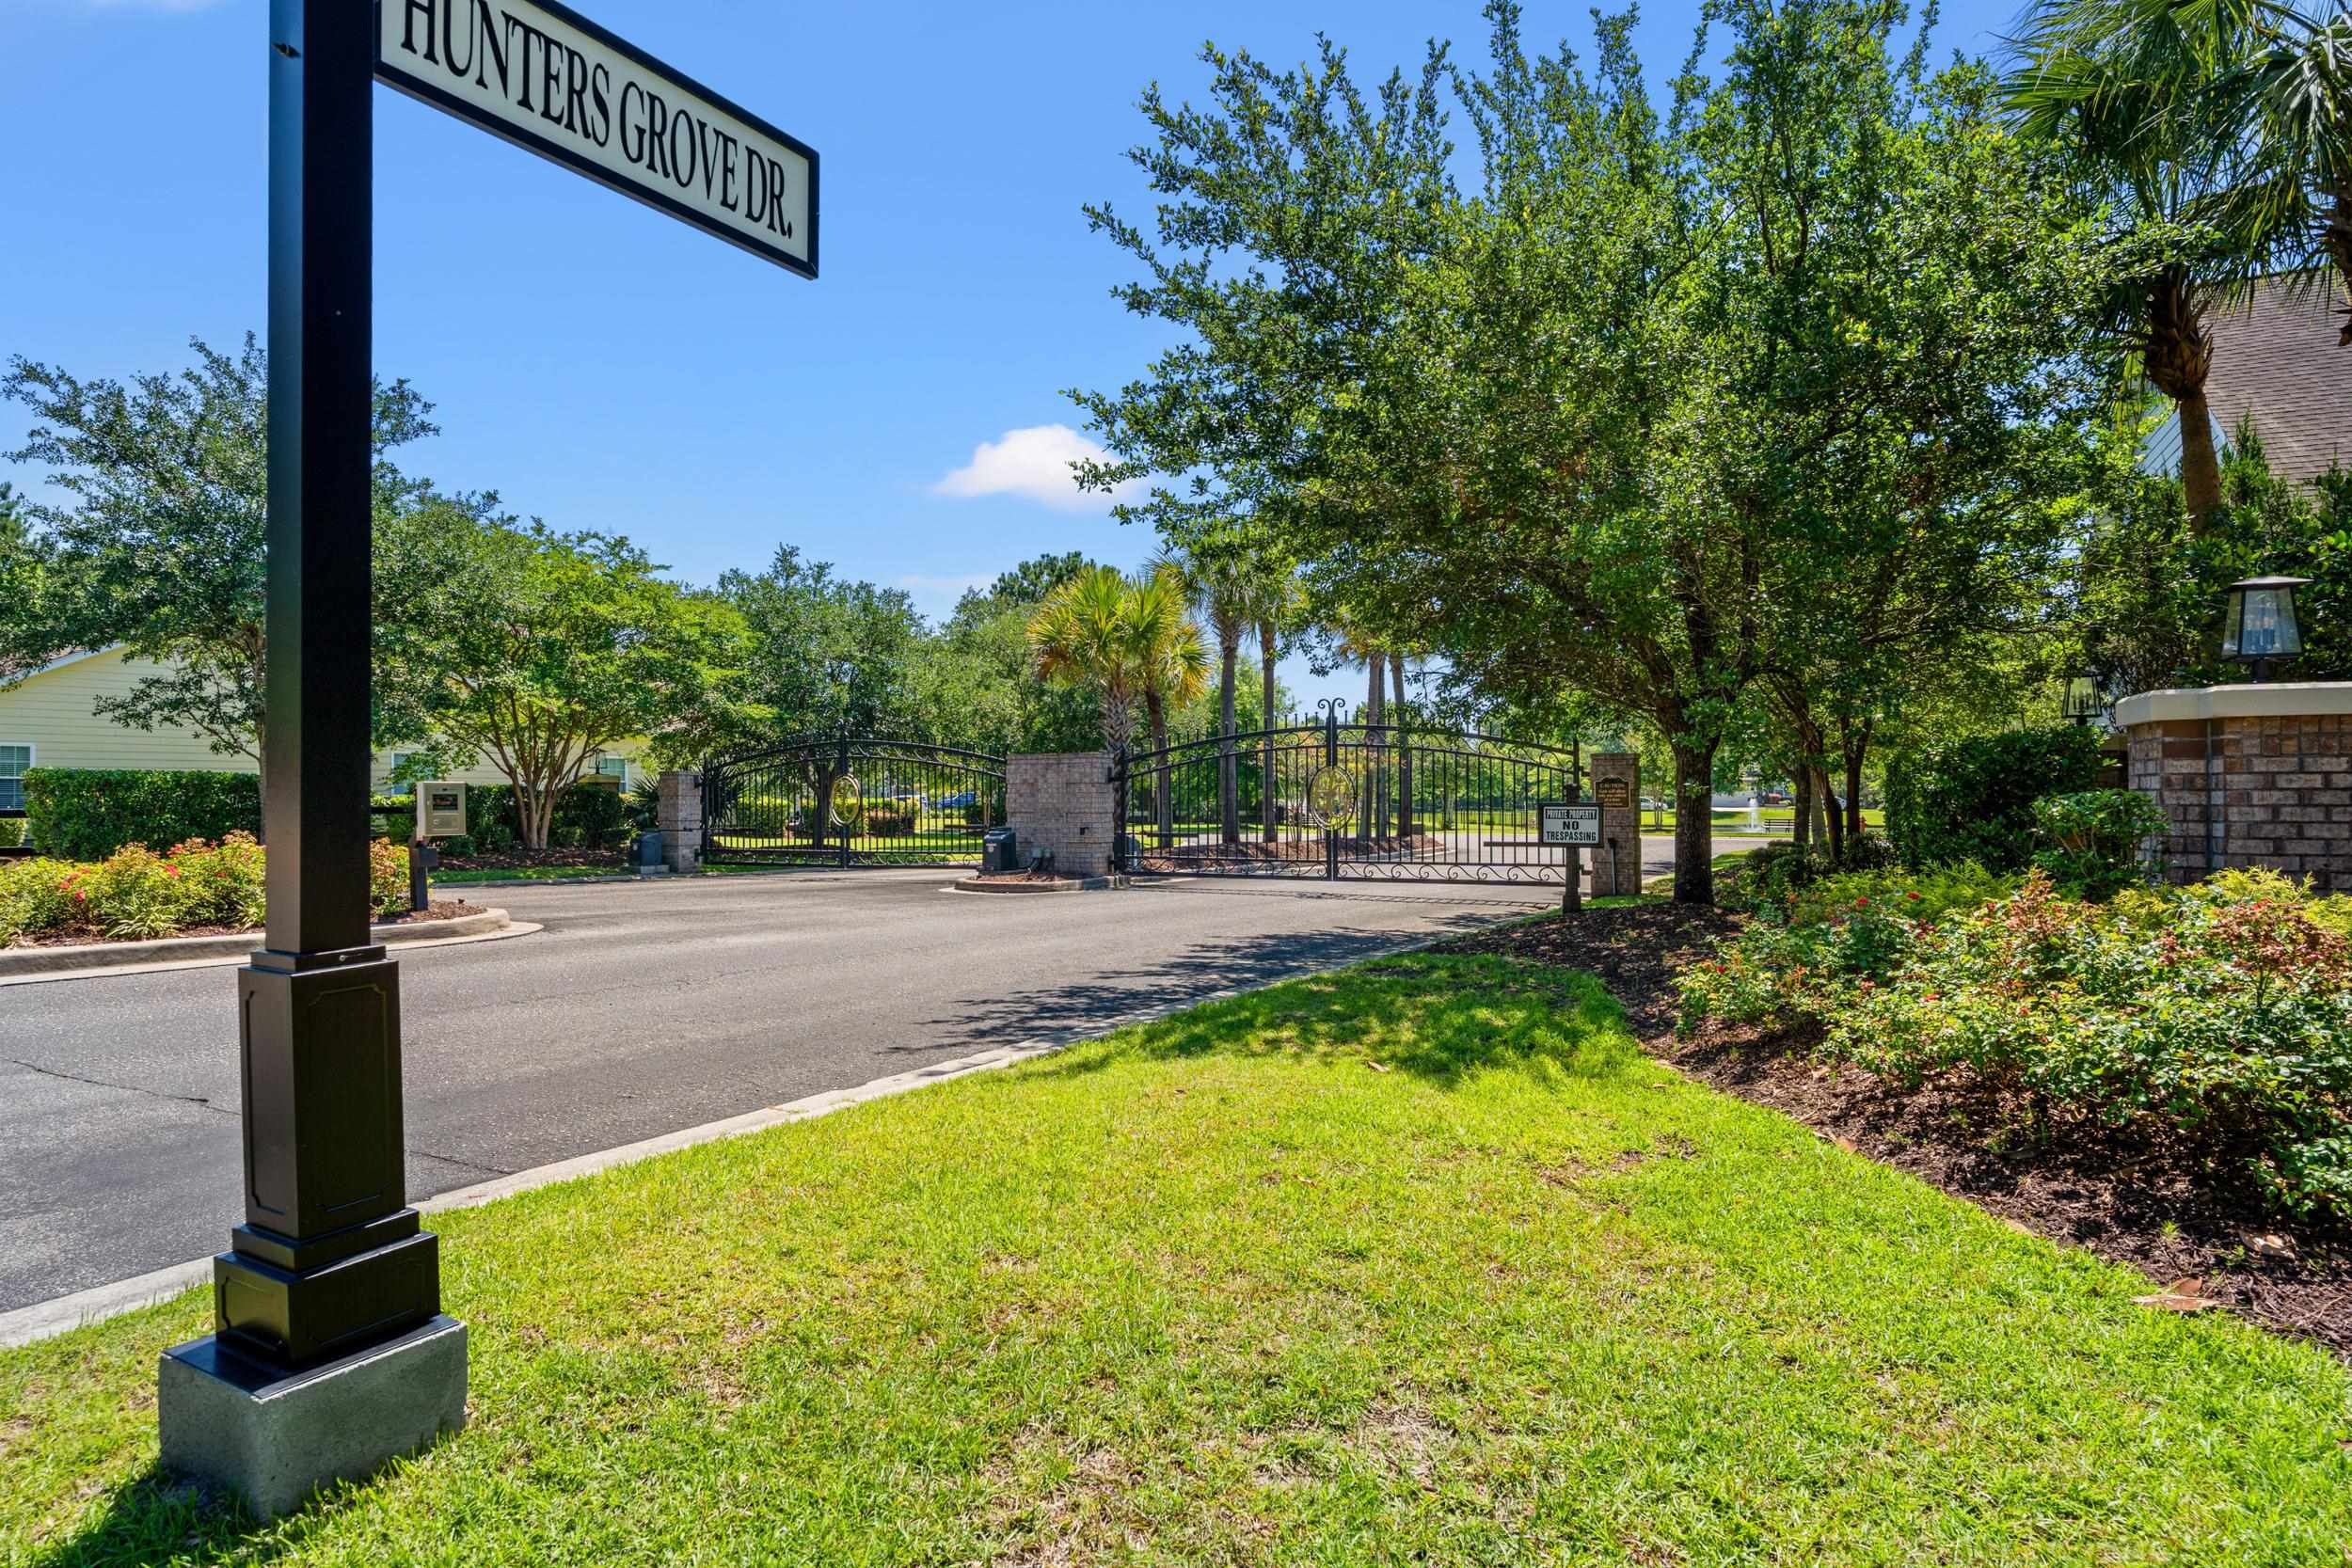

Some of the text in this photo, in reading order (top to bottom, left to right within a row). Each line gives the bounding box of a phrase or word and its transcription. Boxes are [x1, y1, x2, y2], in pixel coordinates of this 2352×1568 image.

[401, 0, 792, 239] HUNTERS GROVE DR.
[1546, 810, 1597, 819] PRIVATE PROPERTY
[1563, 821, 1580, 830] NO
[1547, 832, 1597, 841] TRESPASSING
